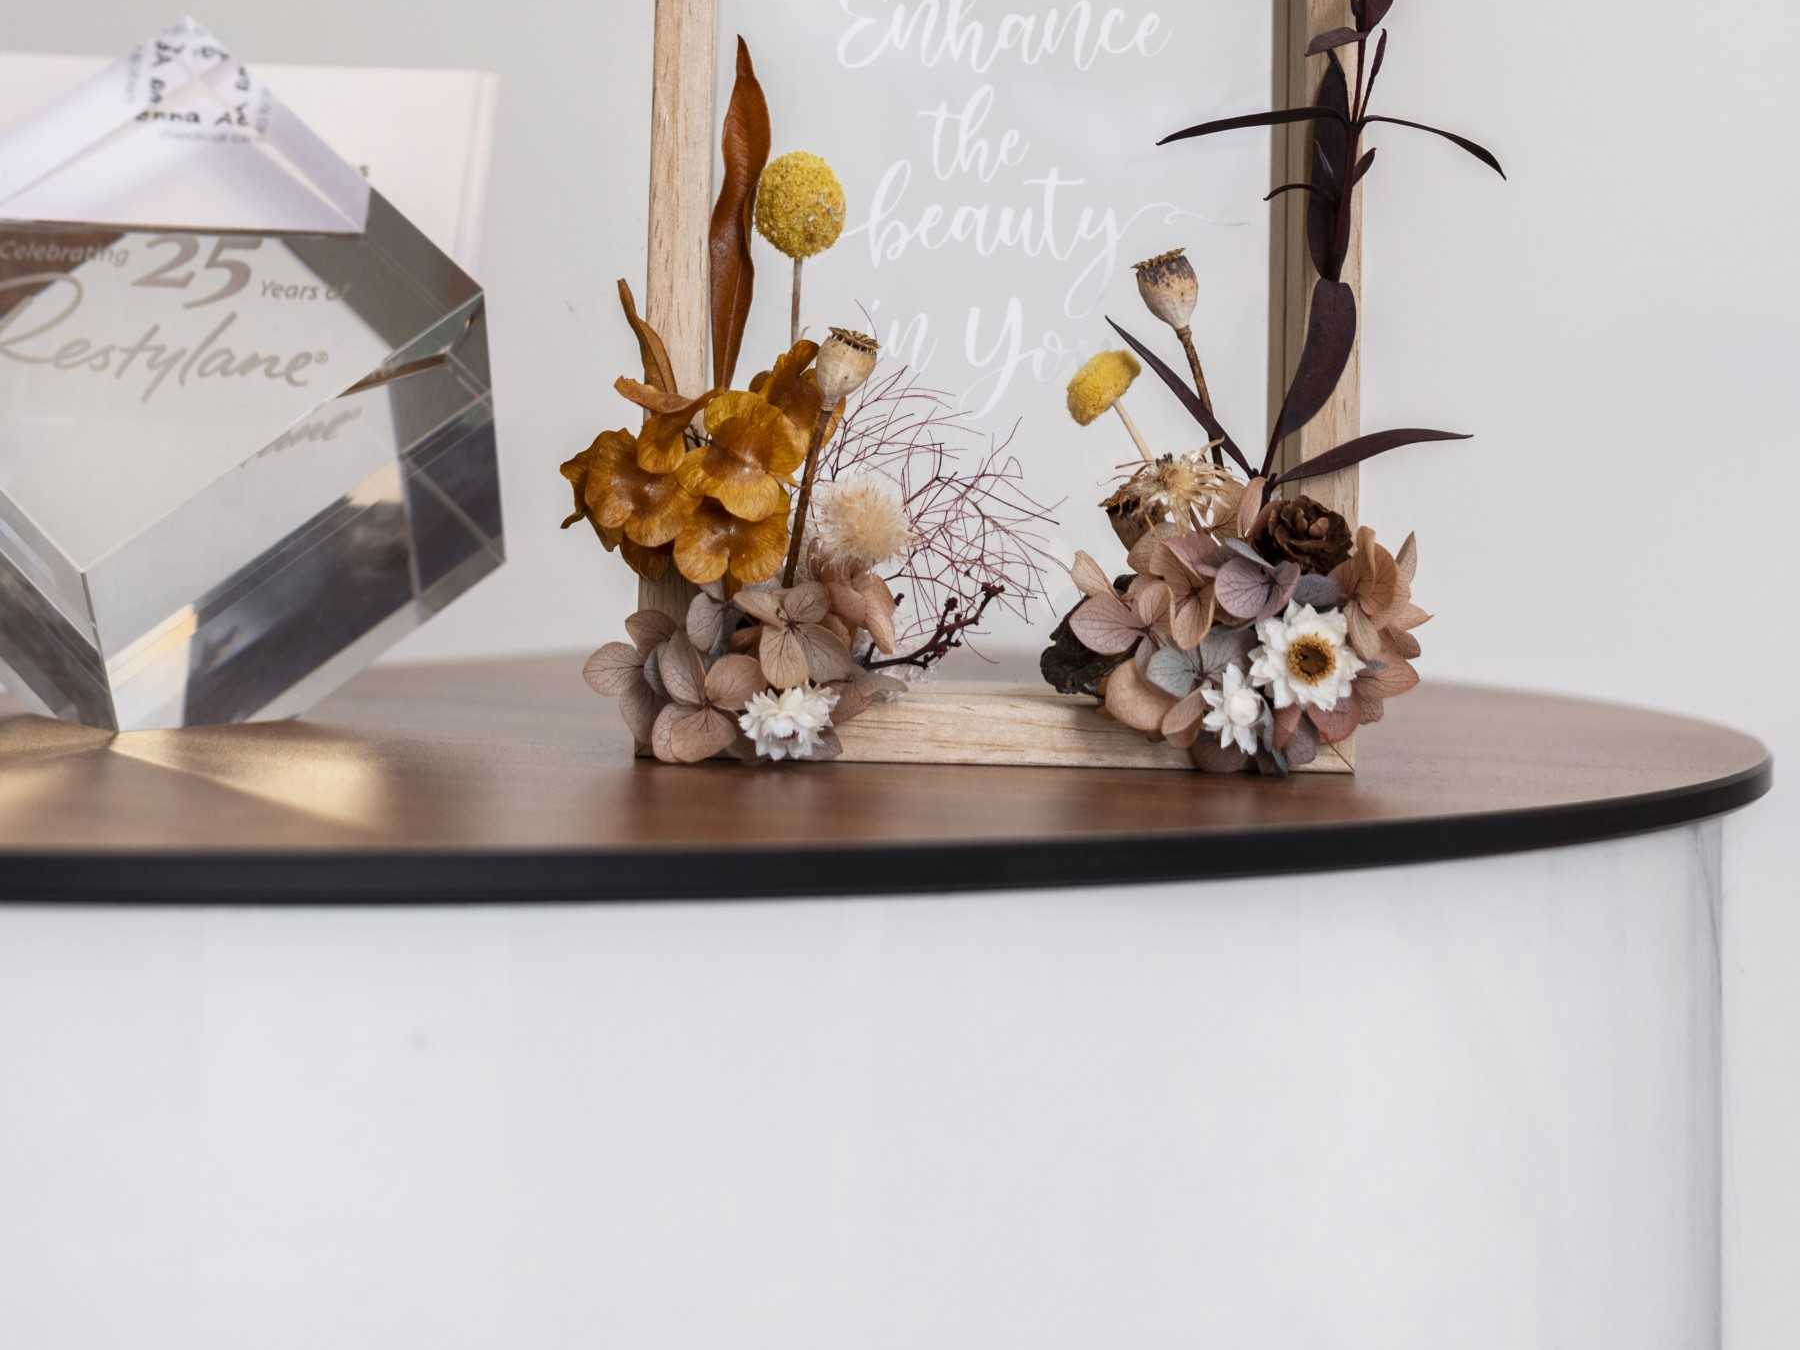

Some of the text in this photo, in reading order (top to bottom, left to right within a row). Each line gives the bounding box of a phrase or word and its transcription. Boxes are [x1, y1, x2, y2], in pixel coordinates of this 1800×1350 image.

[918, 84, 1030, 183] the
[0, 240, 129, 267] Celebrating
[131, 235, 264, 309] 25
[261, 279, 319, 301] Years
[842, 160, 1250, 318] beauty
[960, 297, 1090, 421] Yo
